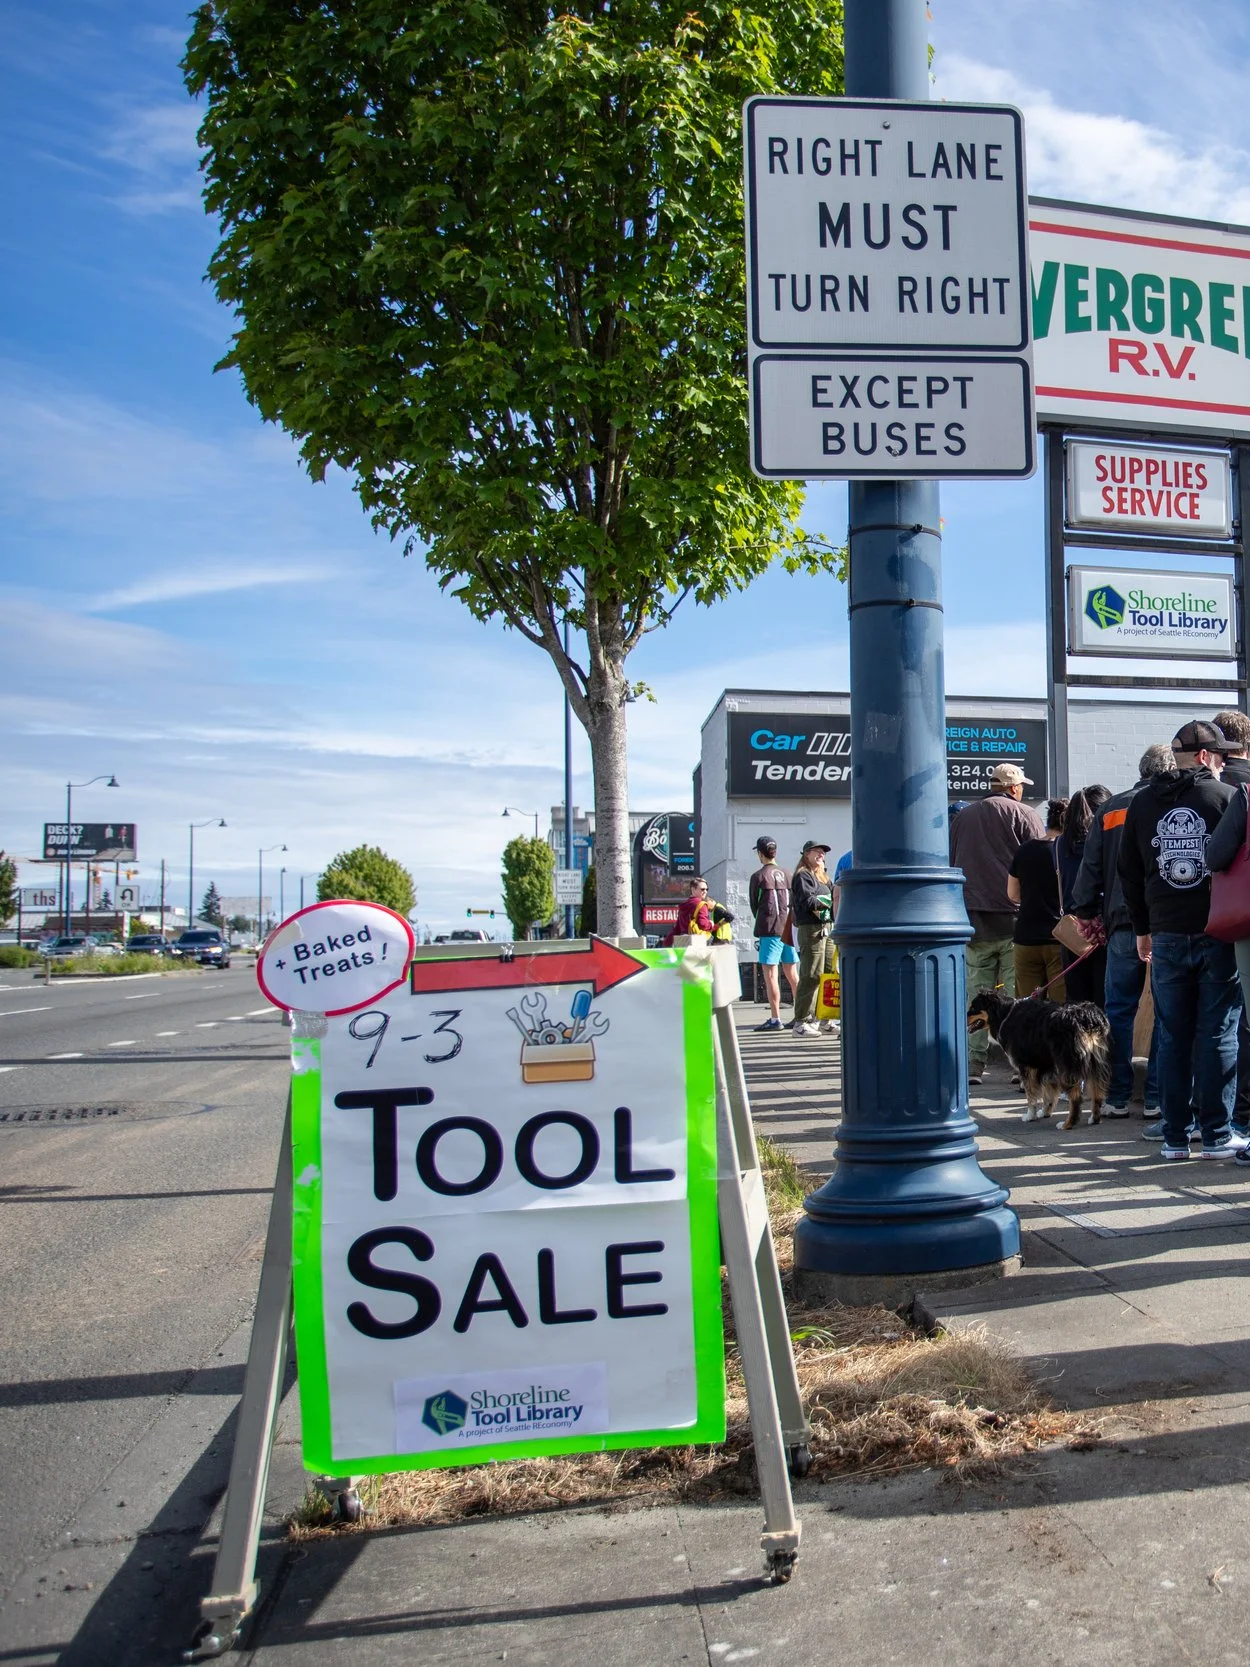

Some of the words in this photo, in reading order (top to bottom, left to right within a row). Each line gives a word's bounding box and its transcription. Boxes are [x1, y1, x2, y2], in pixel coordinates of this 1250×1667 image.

[768, 136, 883, 177] RIGHT
[907, 141, 1004, 181] LANE
[818, 202, 958, 251] MUST
[768, 273, 870, 313] TURN
[898, 276, 1011, 315] RIGHT
[1108, 338, 1196, 381] R.V.
[811, 375, 974, 410] EXCEPT
[822, 422, 967, 457] BUSES
[1095, 454, 1208, 490] SUPPLIES
[1101, 485, 1201, 520] SERVICE
[1128, 589, 1217, 614] Shoreline
[1123, 627, 1149, 636] project
[1158, 628, 1182, 637] Seattle
[1183, 630, 1219, 639] REconomy
[1128, 610, 1164, 627] Tool
[1168, 612, 1229, 634] Library
[750, 729, 806, 751] Car
[981, 728, 1017, 739] AUTO
[970, 741, 980, 752] &
[982, 742, 1027, 753] REPAIR
[751, 760, 851, 781] Tender
[47, 825, 84, 835] DECK?
[1164, 838, 1200, 849] TEMPEST
[1164, 850, 1201, 859] TECHNOLOGIES
[293, 925, 373, 962] Baked
[348, 1009, 464, 1069] 9-3
[333, 1086, 677, 1202] TOOL
[346, 1225, 669, 1340] SALE
[470, 1385, 571, 1410] Shoreline
[471, 1407, 511, 1427] Tool
[516, 1404, 584, 1423] Library
[466, 1428, 494, 1439] project
[495, 1426, 504, 1434] of
[505, 1423, 532, 1433] Seattle
[533, 1420, 573, 1430] REconomy
